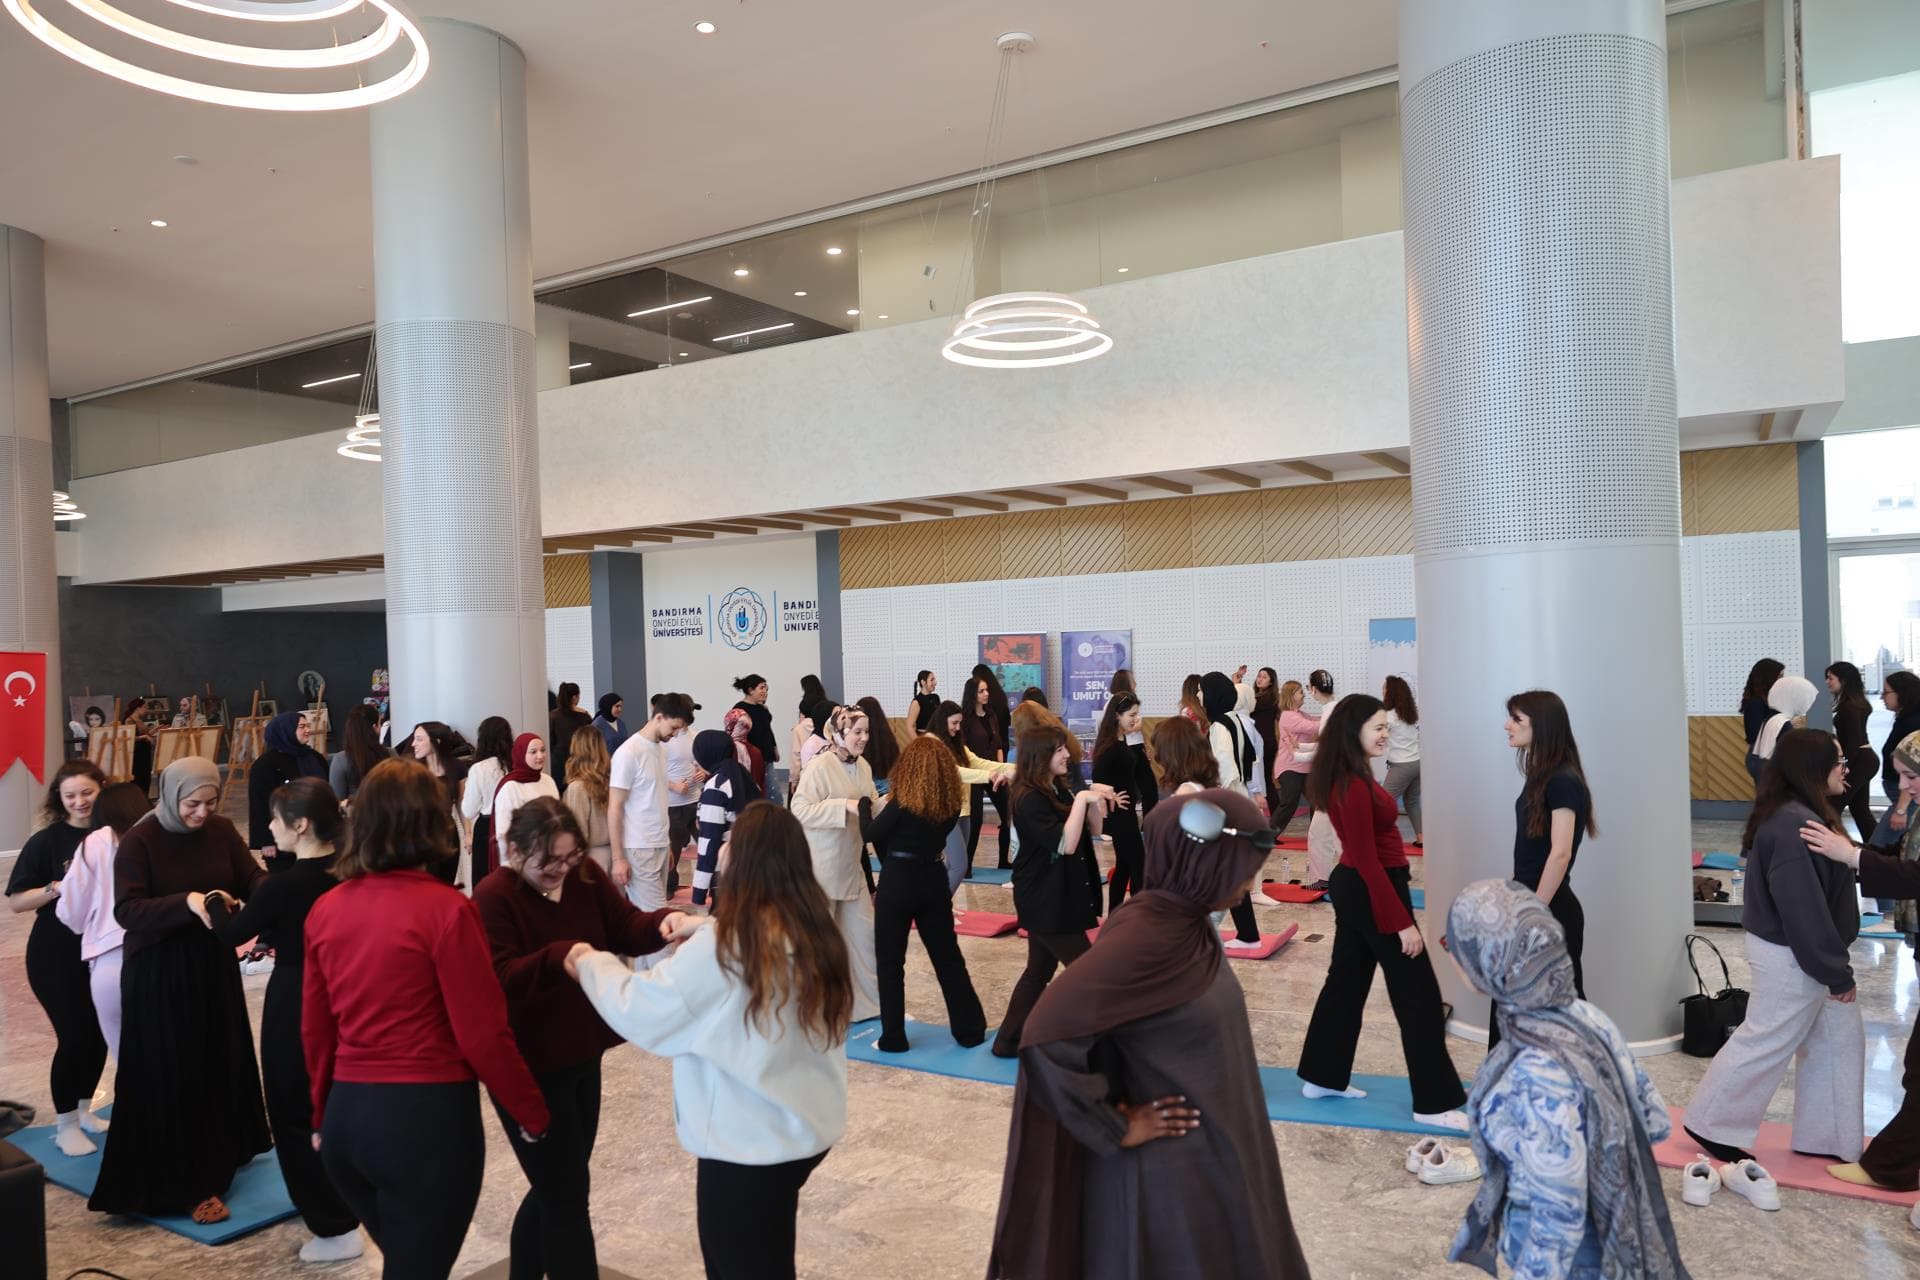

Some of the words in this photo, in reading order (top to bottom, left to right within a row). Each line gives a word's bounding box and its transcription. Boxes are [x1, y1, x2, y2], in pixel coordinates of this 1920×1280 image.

[652, 607, 702, 617] BANDIRMA
[652, 616, 679, 628] ONYEDİ
[680, 616, 703, 627] EYLÜL
[652, 626, 703, 638] ÜNİVERSİTESİ
[1085, 681, 1108, 691] SEN,
[1072, 691, 1102, 701] UMUT
